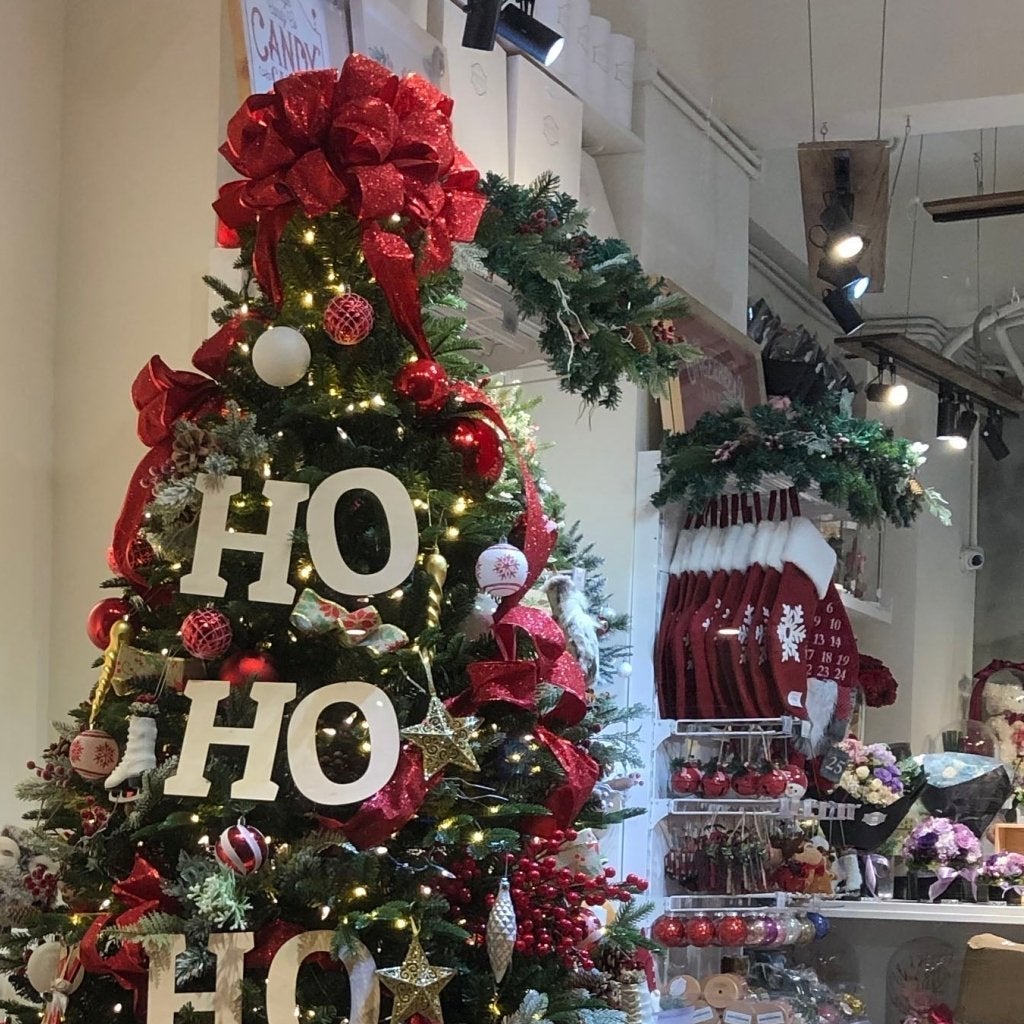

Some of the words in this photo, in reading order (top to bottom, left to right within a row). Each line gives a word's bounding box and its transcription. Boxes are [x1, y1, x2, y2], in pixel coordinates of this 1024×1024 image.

[179, 466, 419, 606] HO
[826, 602, 834, 613] 6
[814, 615, 821, 627] 9
[830, 618, 842, 630] 10
[813, 633, 825, 645] 13
[830, 635, 842, 648] 14
[821, 651, 833, 663] 18
[836, 654, 850, 666] 19
[806, 664, 813, 675] 2
[817, 665, 830, 677] 23
[834, 668, 847, 681] 24
[164, 679, 401, 806] HO
[825, 756, 846, 774] 25
